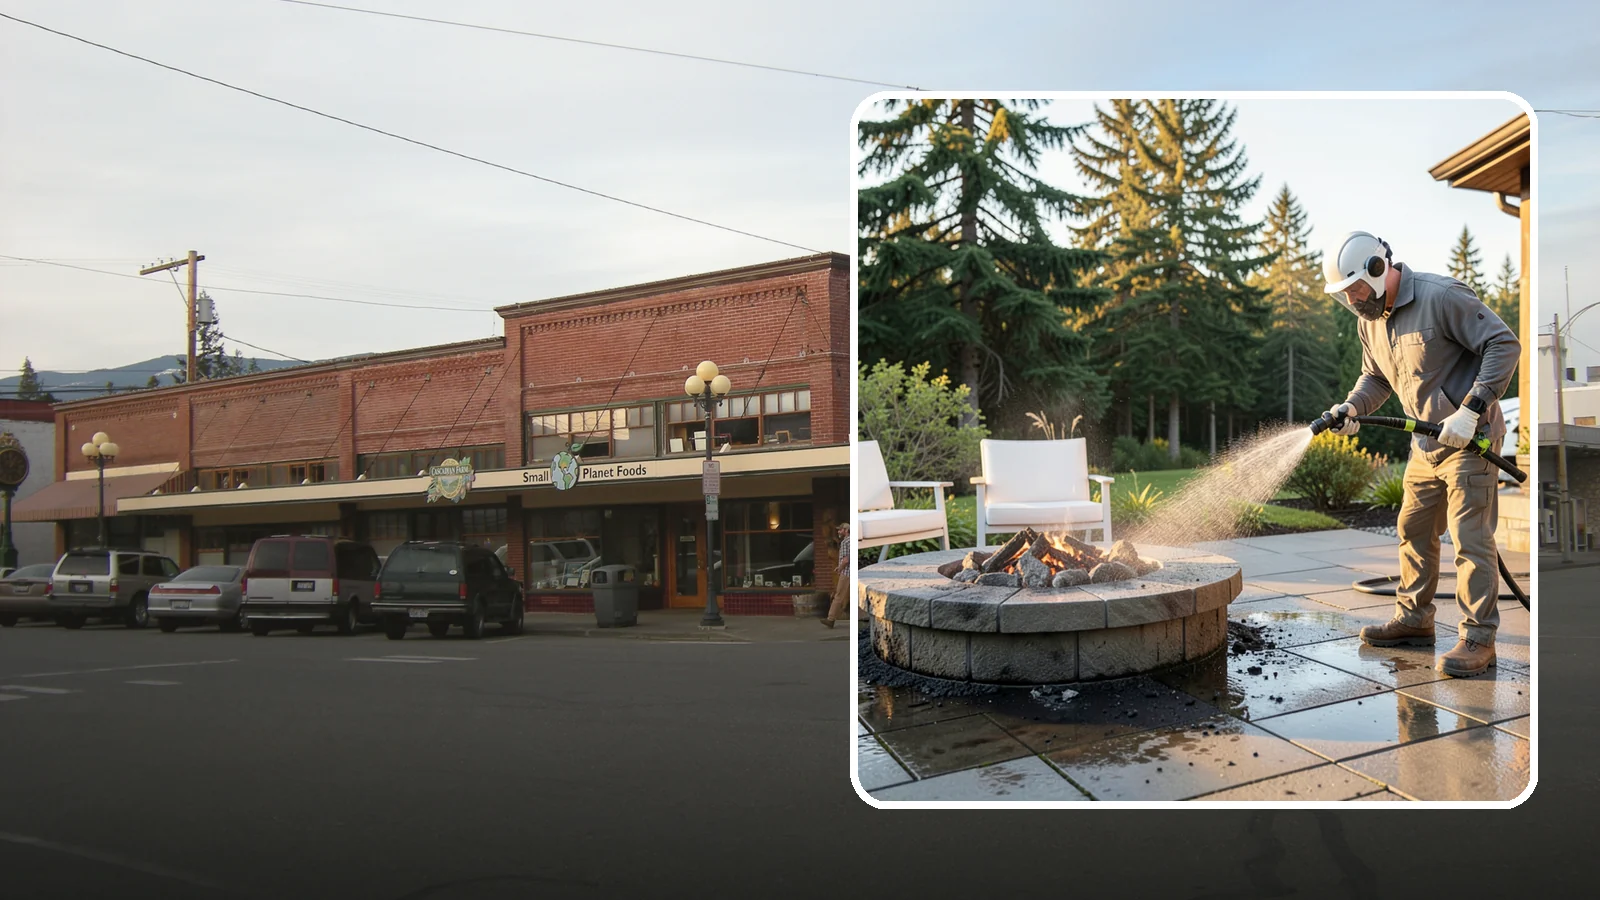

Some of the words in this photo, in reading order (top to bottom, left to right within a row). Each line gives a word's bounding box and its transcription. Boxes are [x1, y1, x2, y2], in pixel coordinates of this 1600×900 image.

[431, 466, 455, 476] CASCADIAN
[456, 465, 469, 474] FARM
[523, 471, 549, 483] Small
[583, 467, 614, 479] Planet
[617, 464, 647, 476] Foods
